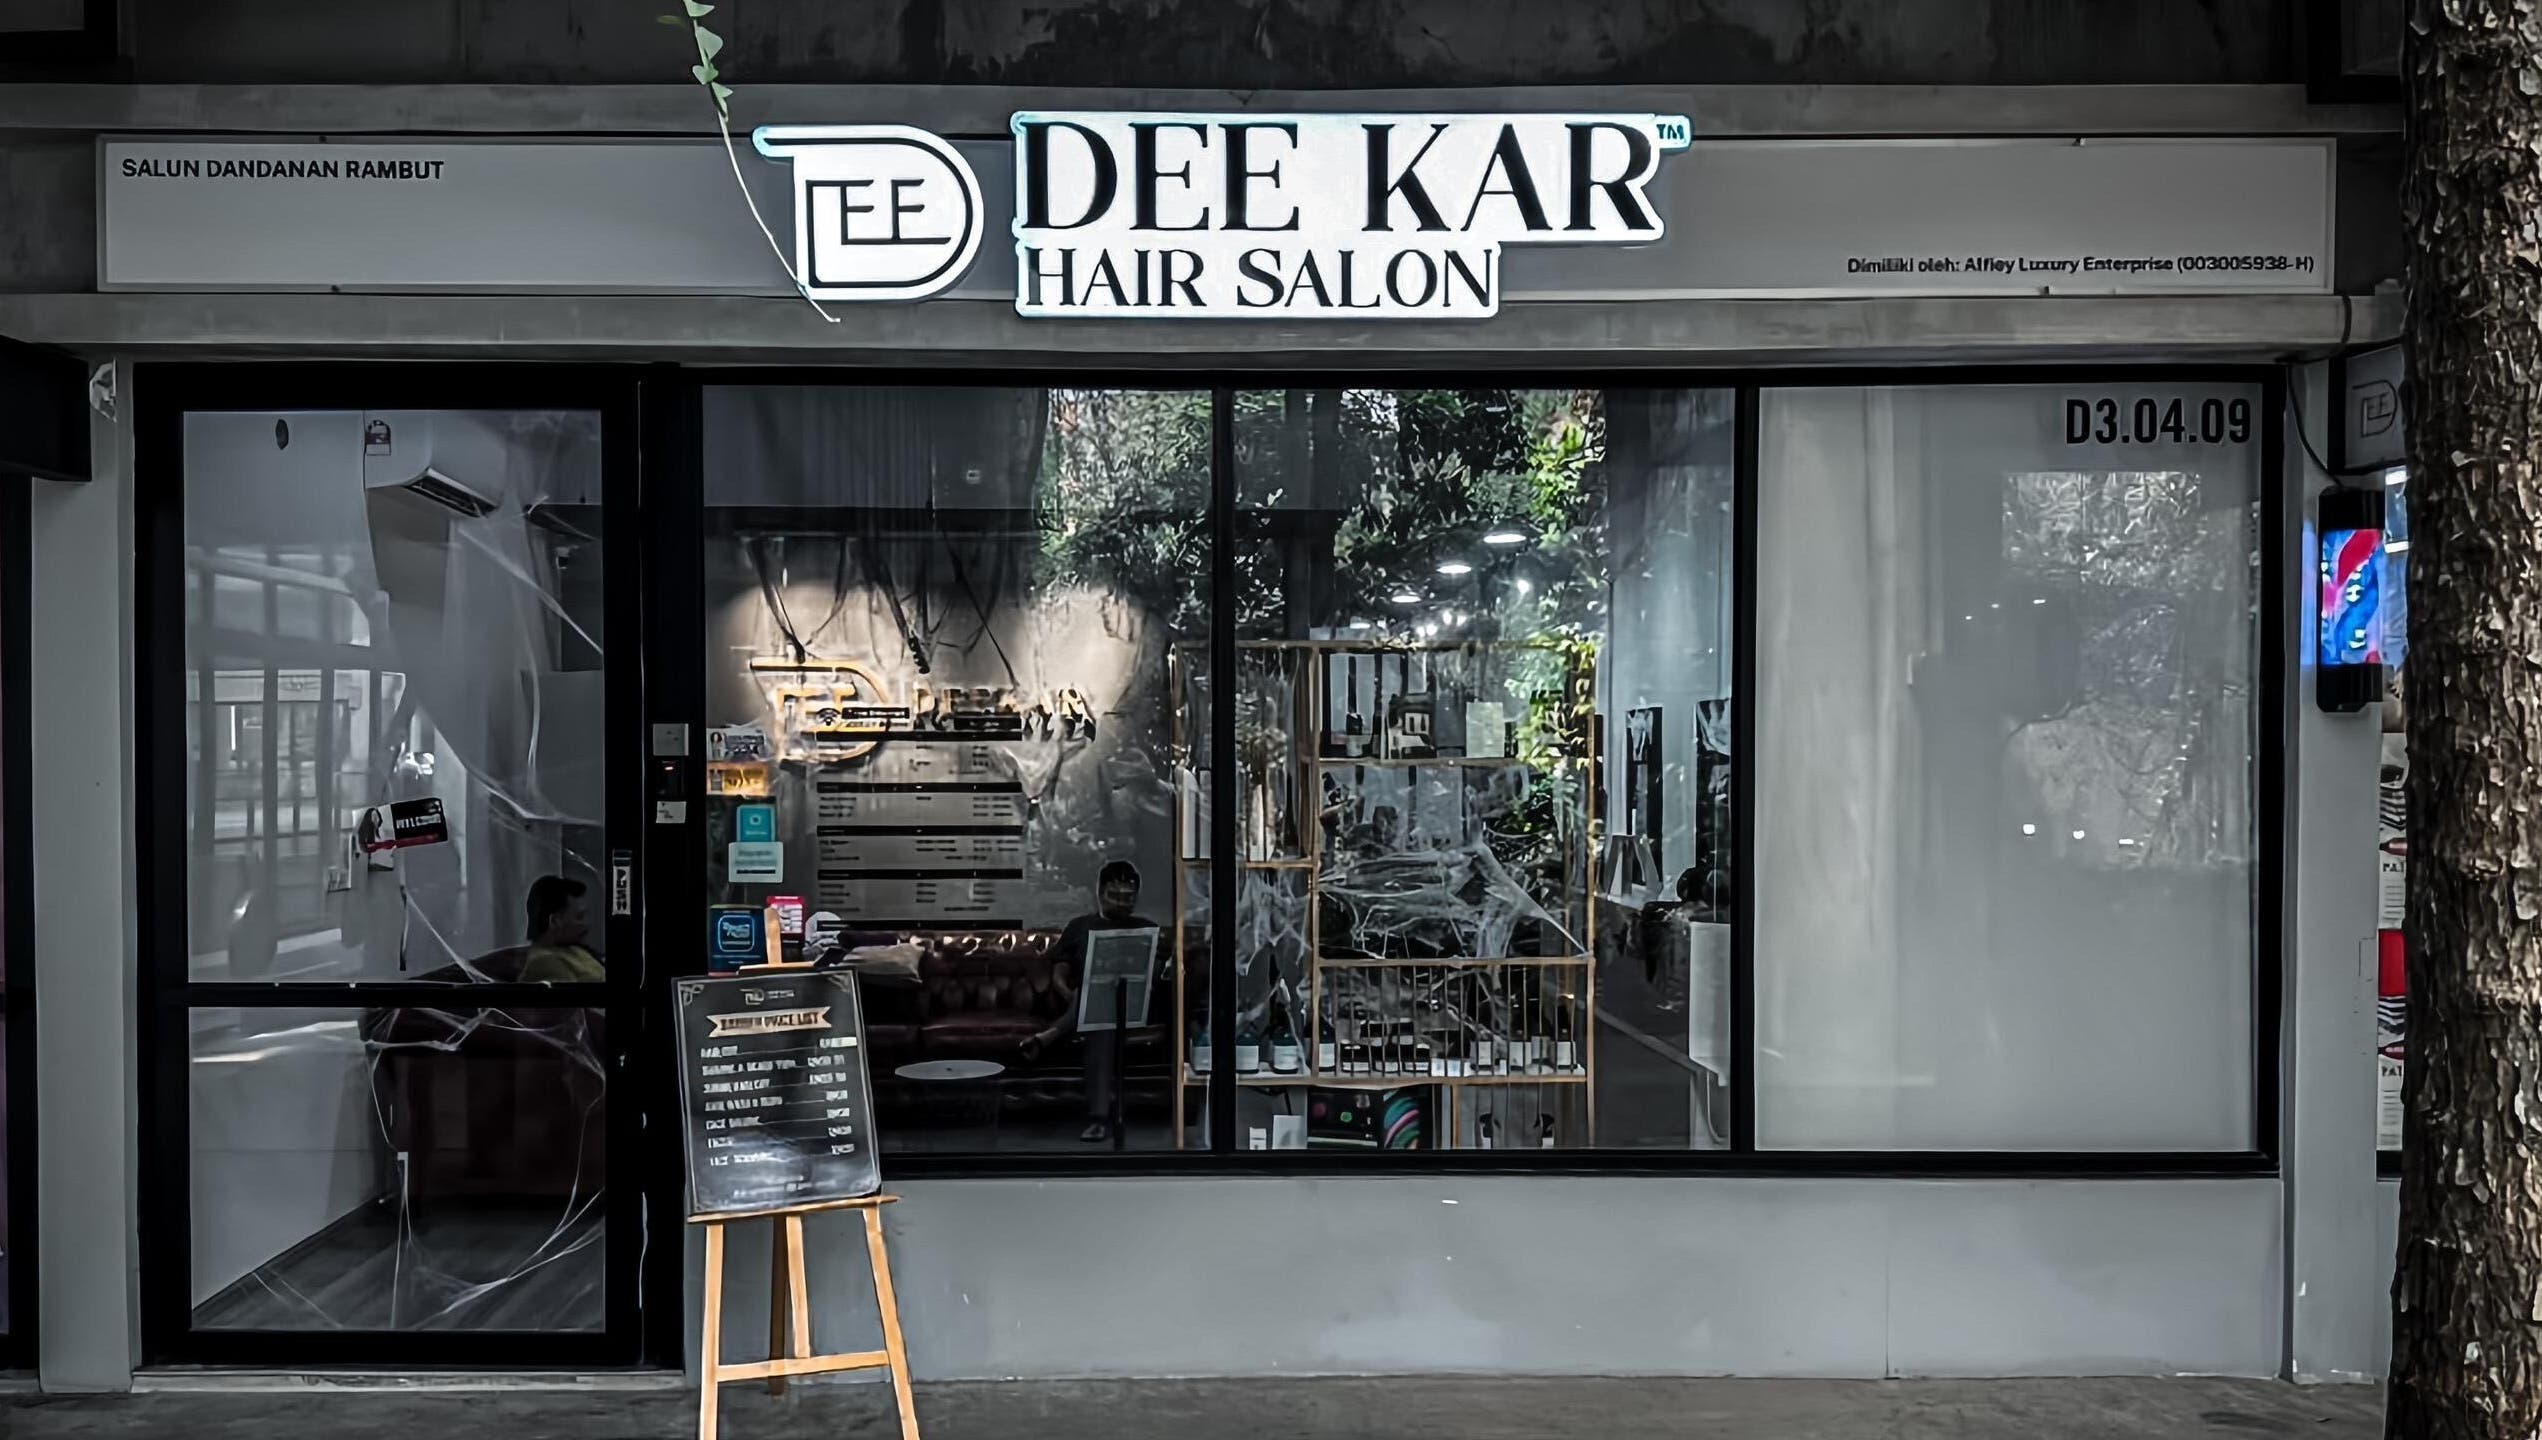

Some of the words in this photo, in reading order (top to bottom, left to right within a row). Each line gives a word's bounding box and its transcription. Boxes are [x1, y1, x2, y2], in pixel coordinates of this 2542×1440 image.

[121, 158, 200, 178] SALUN
[206, 159, 339, 178] DANDANAN
[345, 159, 445, 179] RAMBUT
[1021, 121, 1300, 231] DEE
[1361, 122, 1656, 232] KAR
[1025, 246, 1208, 308] HAIR
[1236, 247, 1493, 309] SALON
[1918, 257, 1960, 273] oleh:
[2018, 257, 2080, 274] Luxury
[2083, 256, 2174, 274] Enterprise
[2065, 397, 2251, 445] D3.04.09
